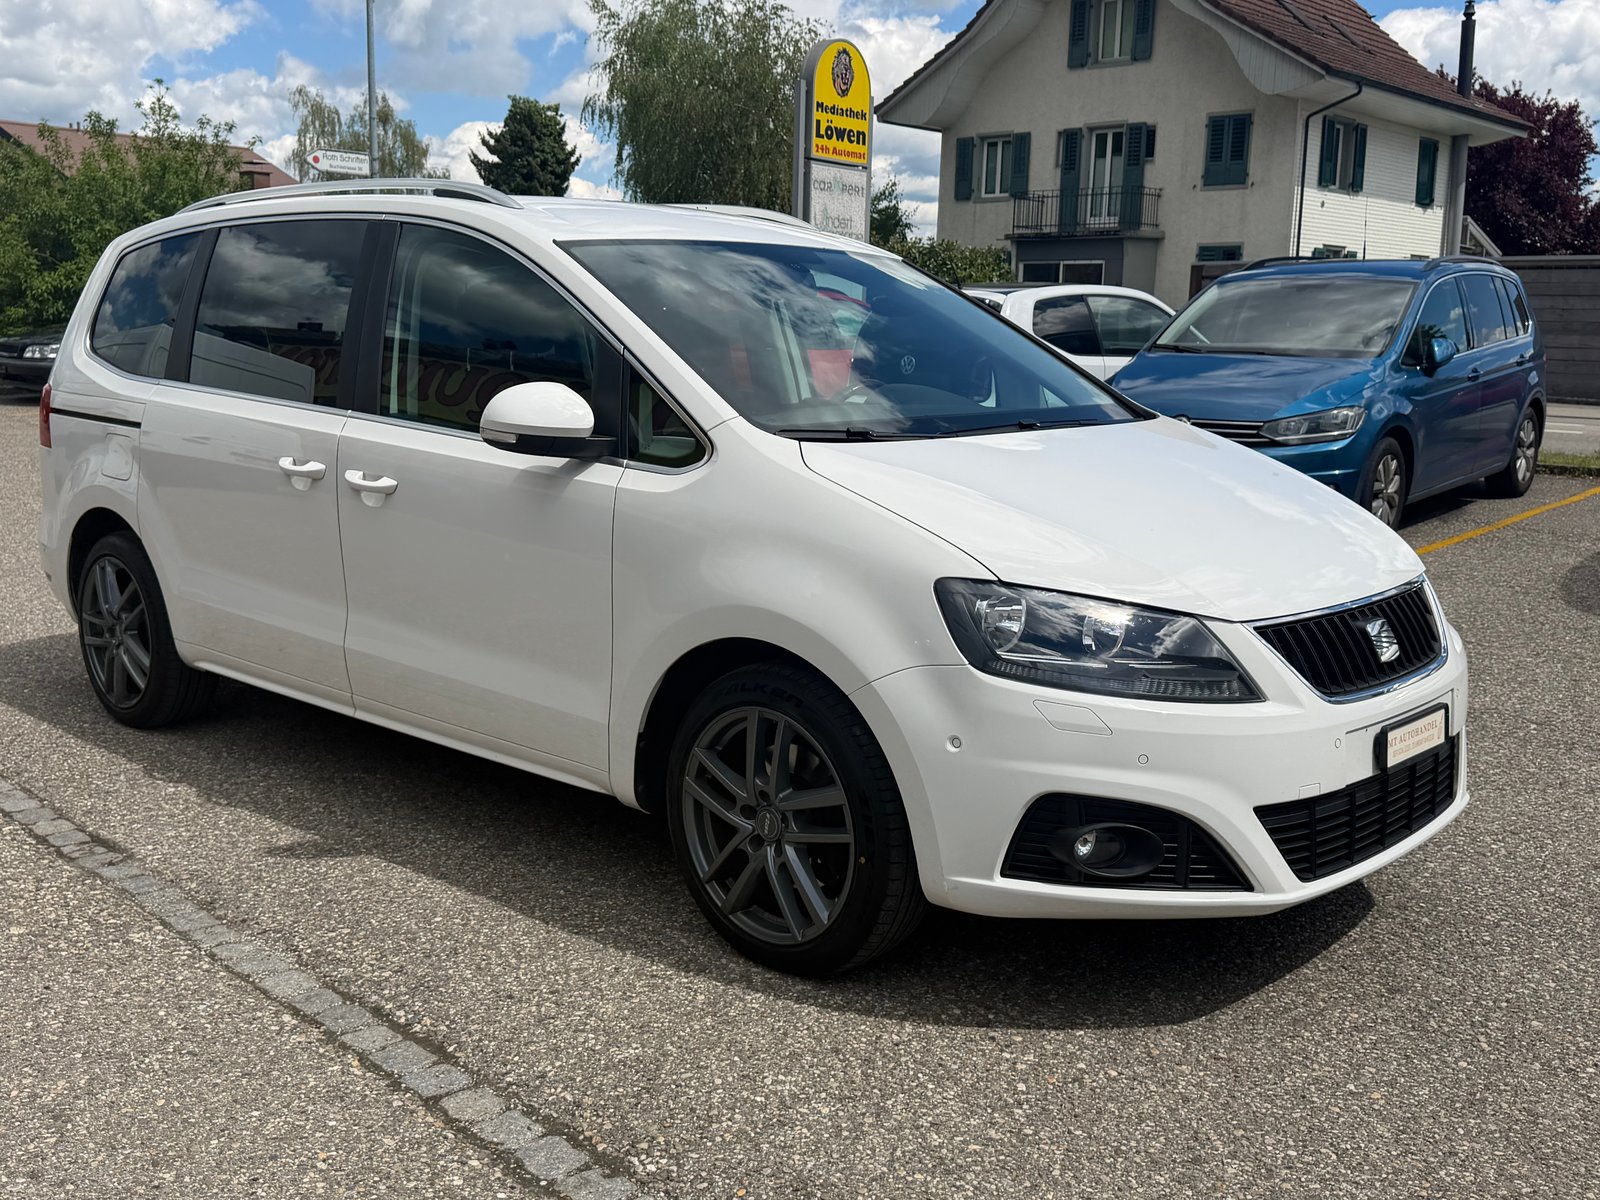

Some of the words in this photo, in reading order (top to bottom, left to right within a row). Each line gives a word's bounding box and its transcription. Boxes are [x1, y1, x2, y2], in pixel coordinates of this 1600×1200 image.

[816, 101, 867, 121] Mediathek
[815, 119, 867, 146] Löwen
[322, 152, 338, 161] Roth
[340, 154, 369, 165] Schriften
[815, 144, 830, 155] 24h
[832, 147, 866, 160] Automat
[1399, 719, 1438, 745] AUTOHANDEL
